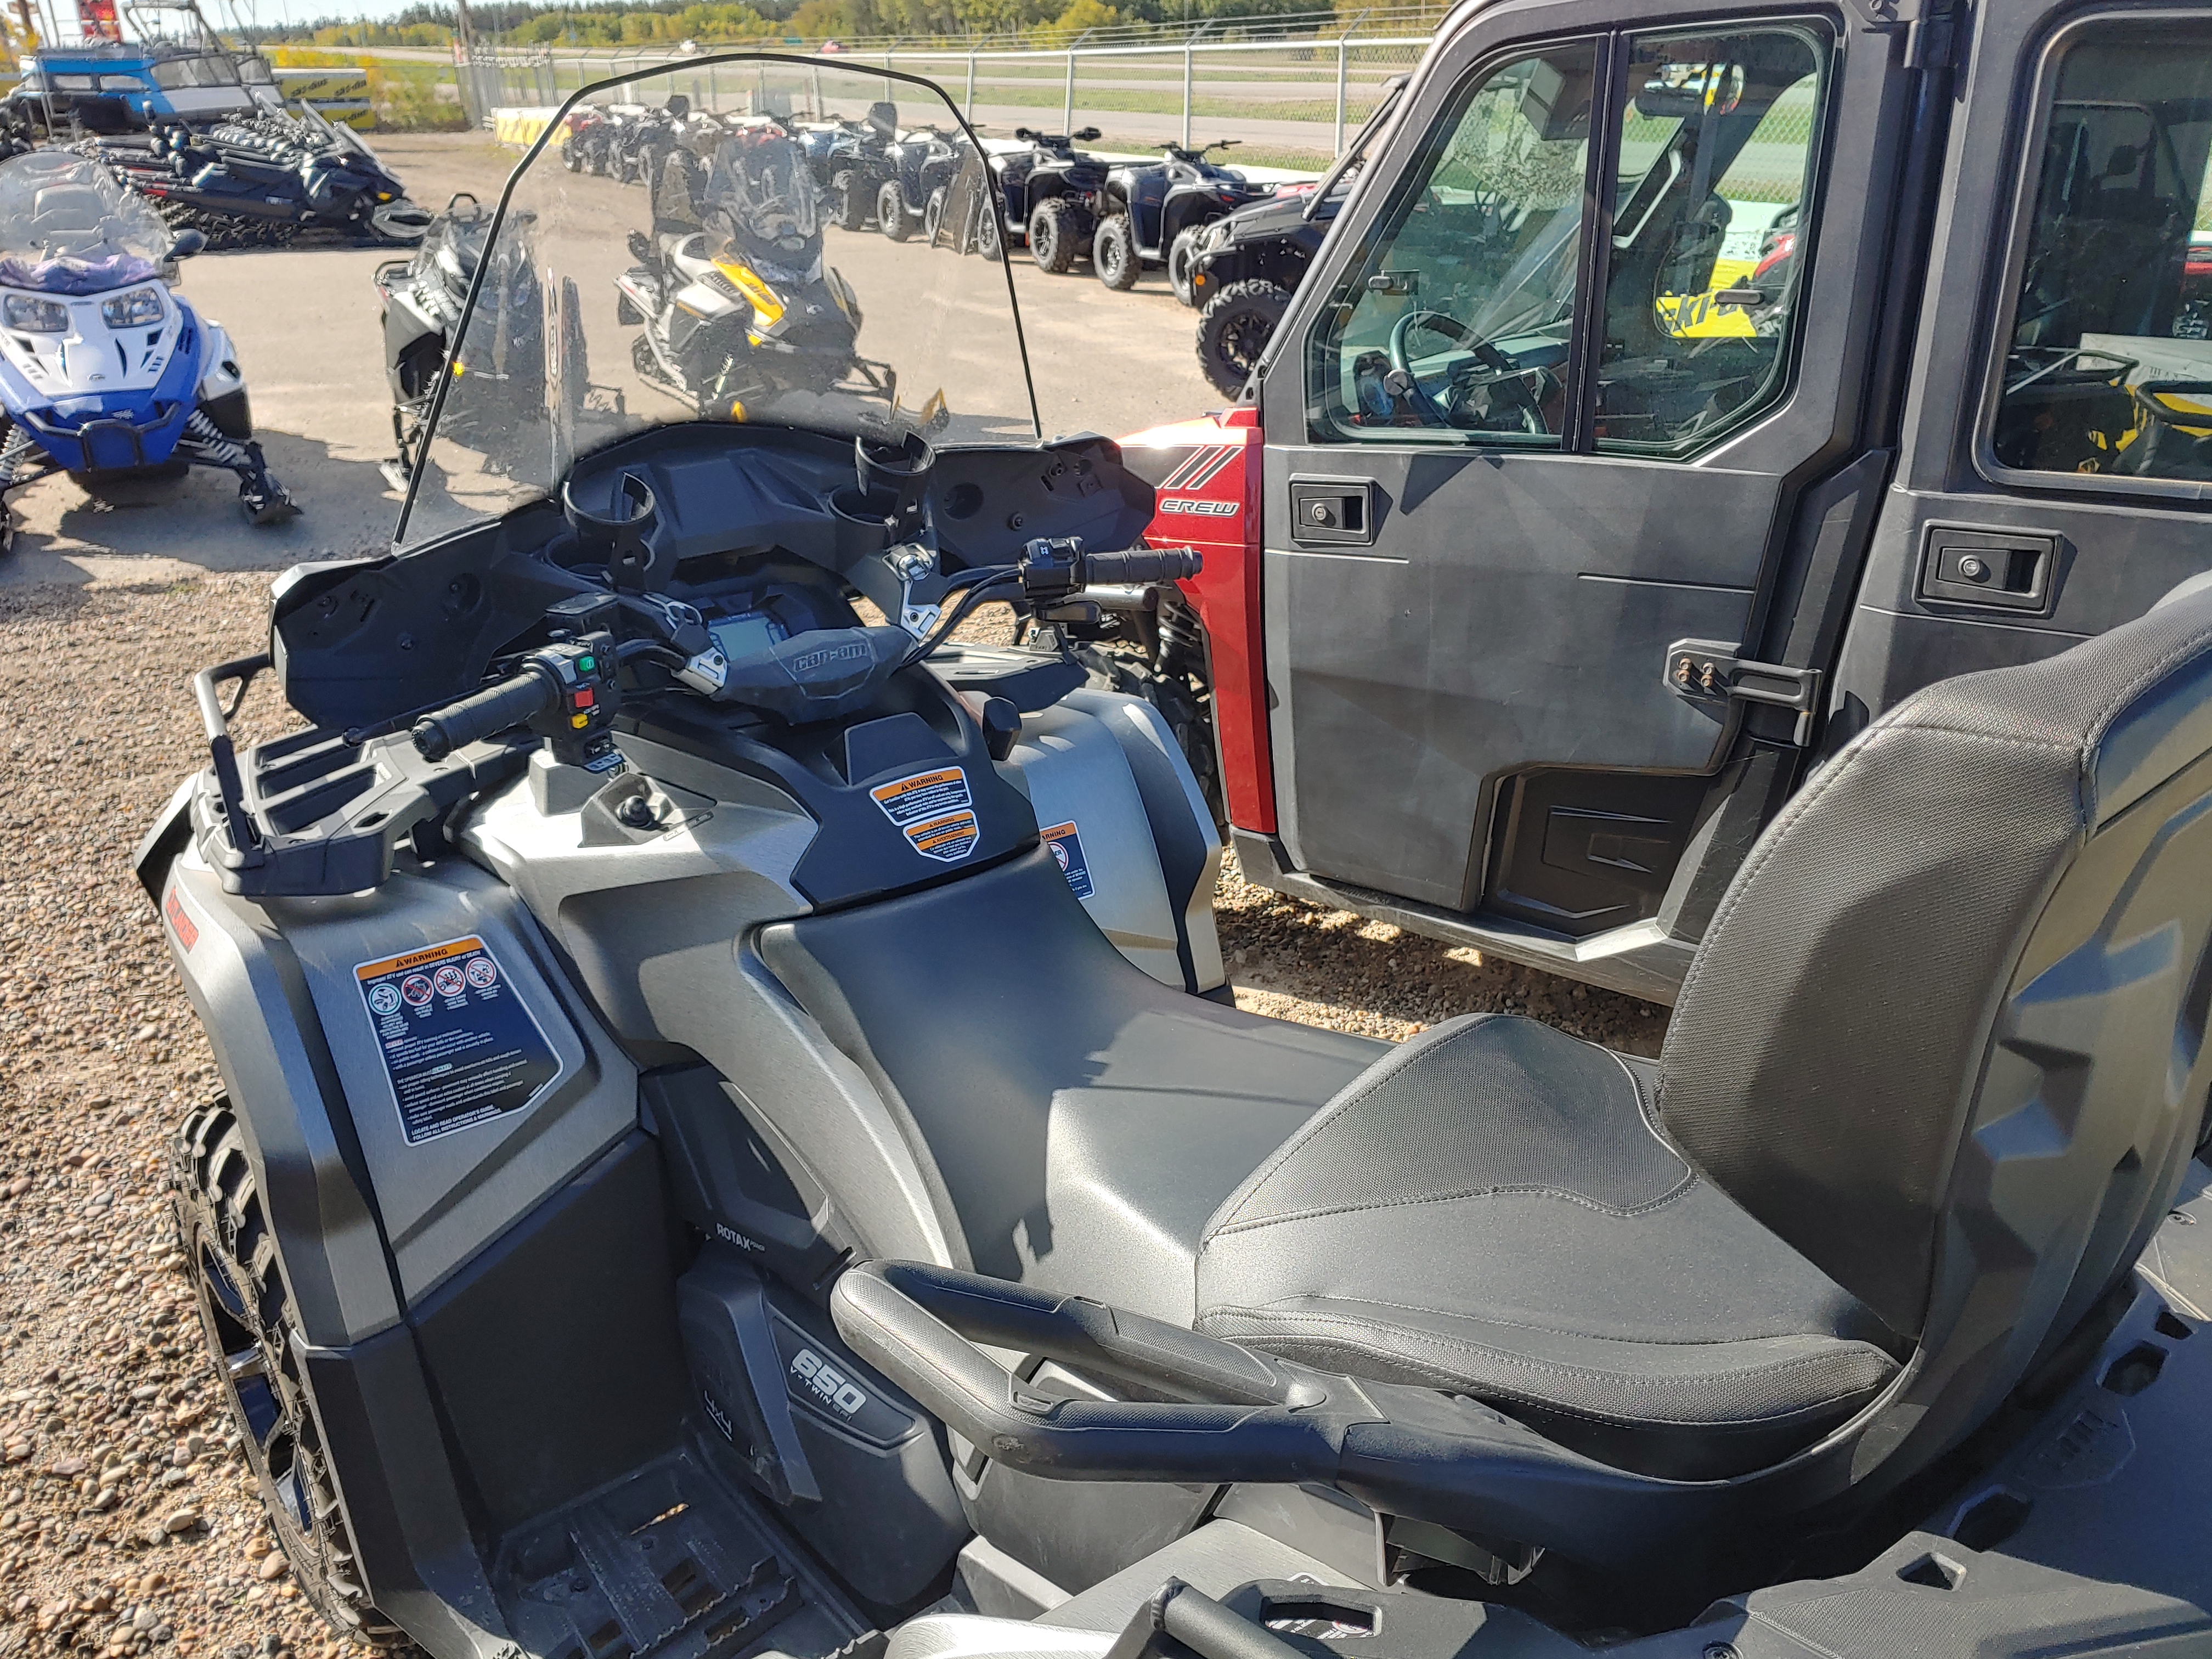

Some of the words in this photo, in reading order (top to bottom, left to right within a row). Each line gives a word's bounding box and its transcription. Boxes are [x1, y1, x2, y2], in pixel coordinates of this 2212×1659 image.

[1160, 499, 1240, 517] CREW
[909, 775, 943, 788] WARNING
[404, 949, 448, 964] WARNING
[716, 1222, 751, 1251] ROTAX
[792, 1348, 866, 1414] 650
